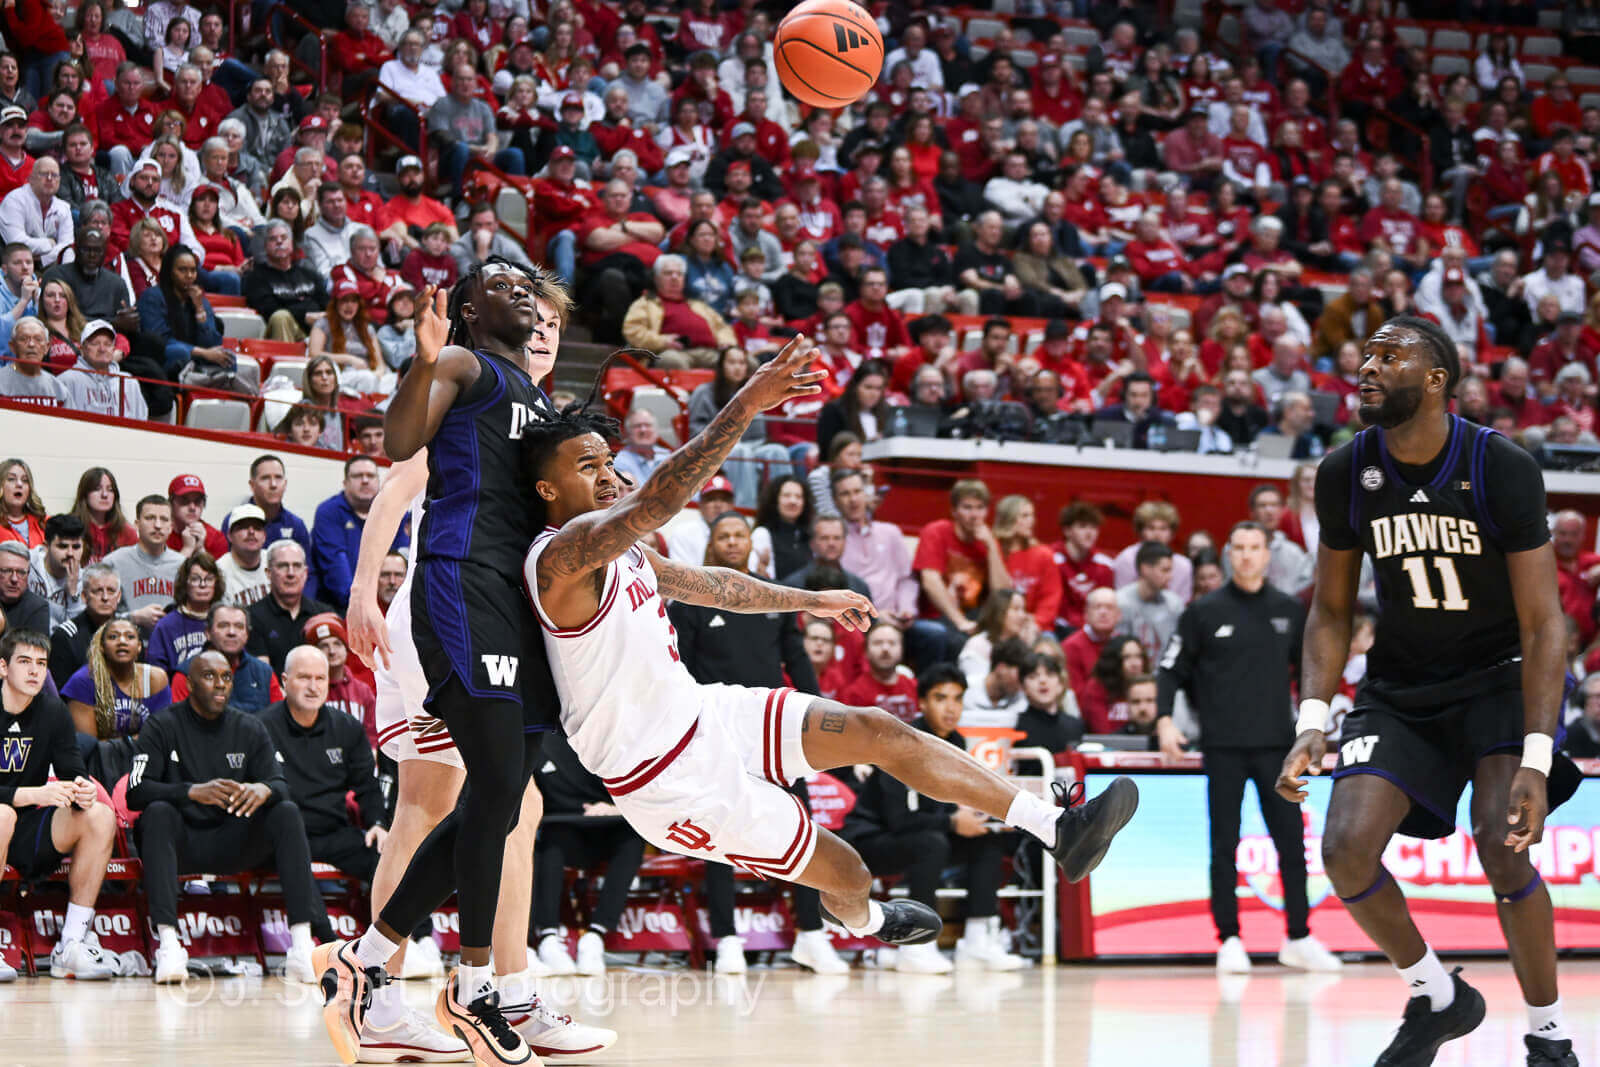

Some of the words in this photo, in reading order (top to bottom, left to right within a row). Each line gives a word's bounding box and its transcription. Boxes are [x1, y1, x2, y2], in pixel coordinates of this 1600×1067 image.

[1370, 512, 1483, 560] DAWGS
[133, 577, 175, 599] INDIAN
[1402, 556, 1469, 612] 11
[481, 653, 518, 687] W
[0, 737, 34, 773] W
[226, 753, 246, 769] W
[326, 747, 343, 764] W
[1341, 735, 1380, 767] W
